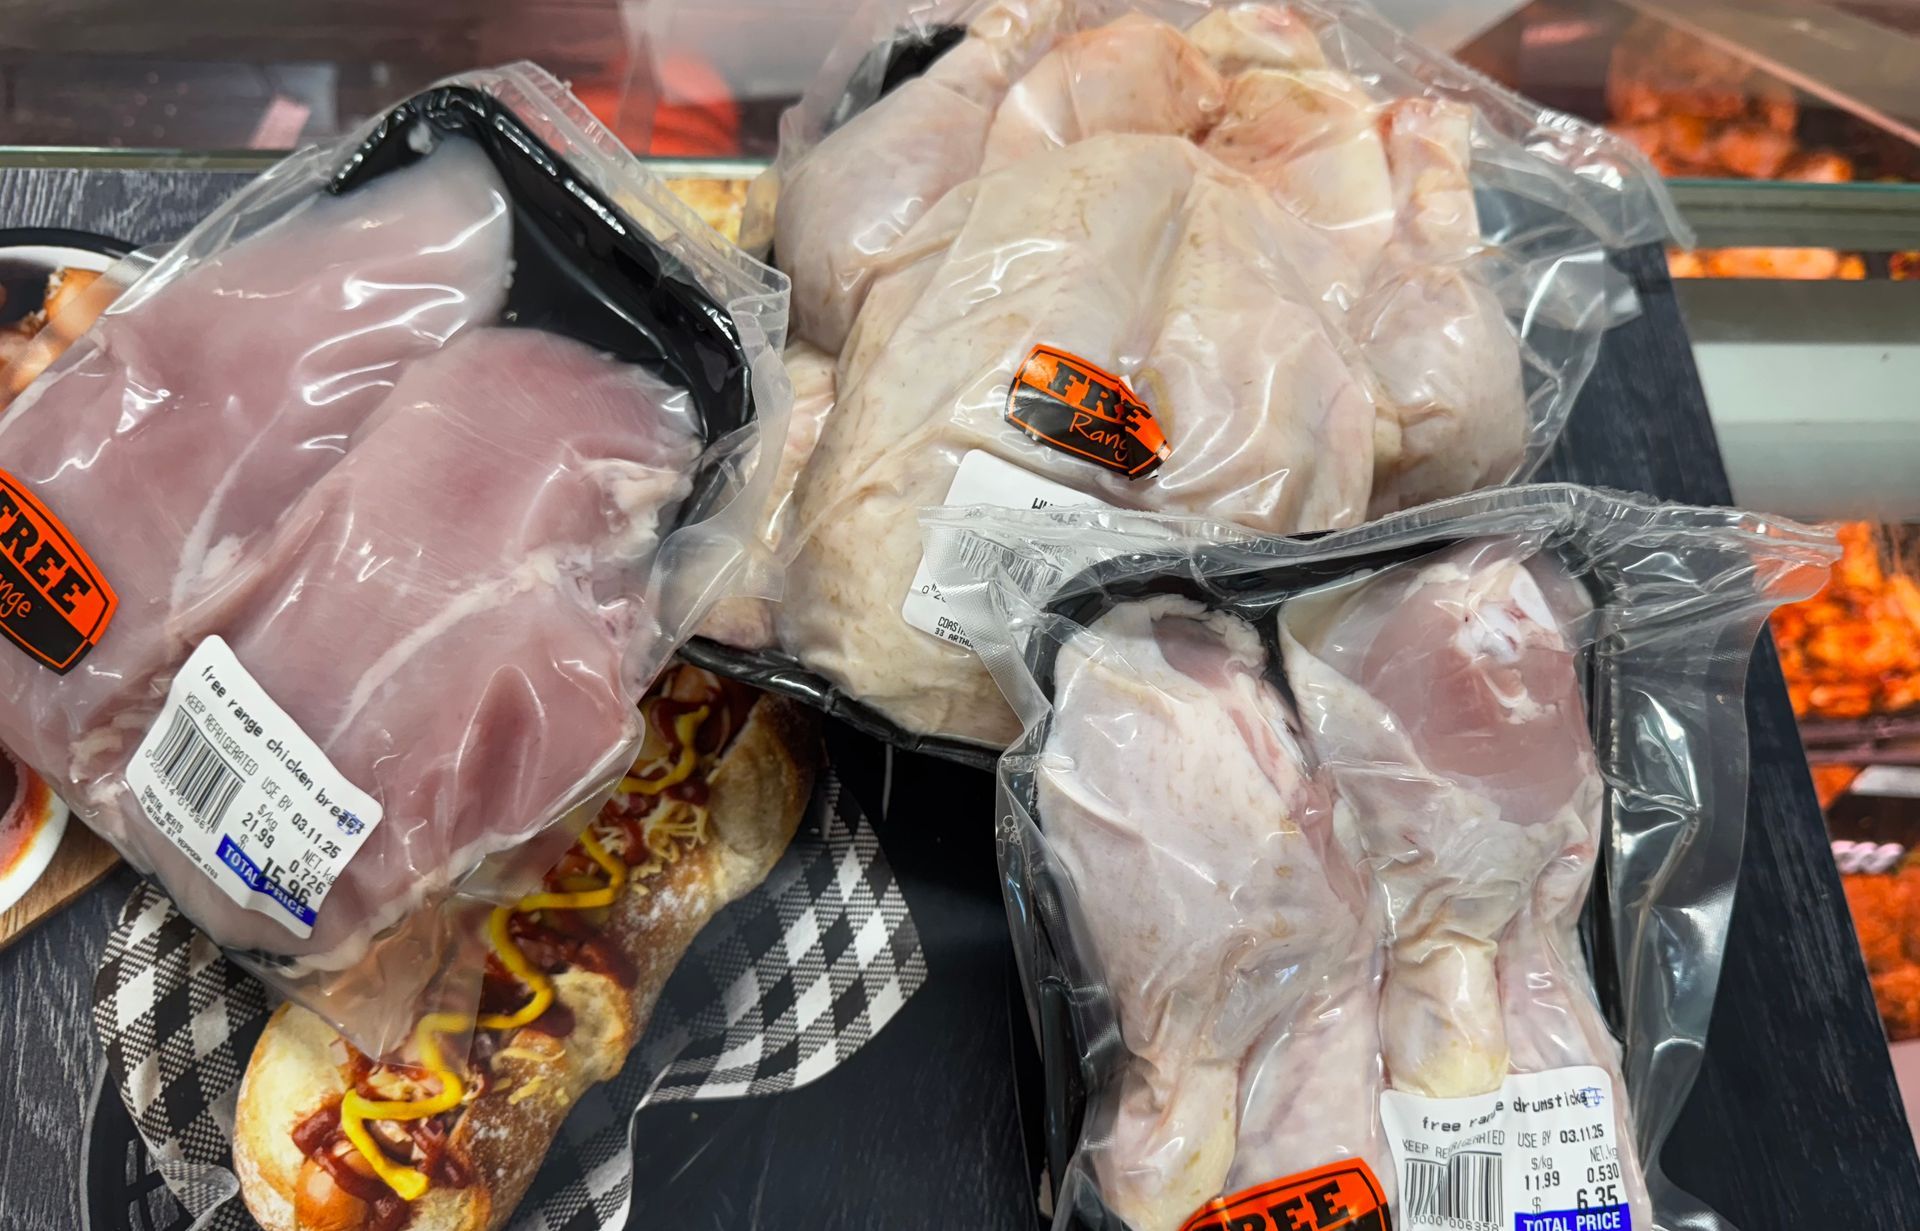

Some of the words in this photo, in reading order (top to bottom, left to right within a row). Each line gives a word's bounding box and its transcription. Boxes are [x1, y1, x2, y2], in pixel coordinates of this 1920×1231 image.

[1069, 411, 1128, 462] Rang
[934, 627, 945, 637] 33
[948, 634, 974, 648] ARTHU
[202, 665, 226, 698] free
[227, 699, 263, 737] range
[266, 739, 314, 791] chicken
[185, 691, 206, 715] KEEP
[204, 713, 259, 776] REFRIGERATED
[261, 776, 281, 799] USE
[278, 794, 293, 812] BY
[291, 812, 342, 859] 03.11.25
[164, 811, 184, 834] MEATS
[242, 812, 275, 849] 21.99
[224, 843, 259, 887] TOTAL
[263, 881, 307, 918] PRICE
[260, 857, 312, 906] 1596
[289, 859, 326, 895] 0.726
[1422, 1116, 1461, 1132] free
[1469, 1100, 1504, 1128] rane
[1513, 1089, 1588, 1113] drumsticks
[1402, 1138, 1429, 1154] KEEP
[1517, 1131, 1538, 1148] USE
[1542, 1130, 1551, 1146] BY
[1559, 1123, 1604, 1144] 03.11.25
[1525, 1170, 1560, 1191] 11.99
[1587, 1162, 1619, 1184] 0.530
[1576, 1184, 1620, 1213] 635
[1523, 1216, 1569, 1231] TOTAL
[1576, 1211, 1621, 1231] PRICE
